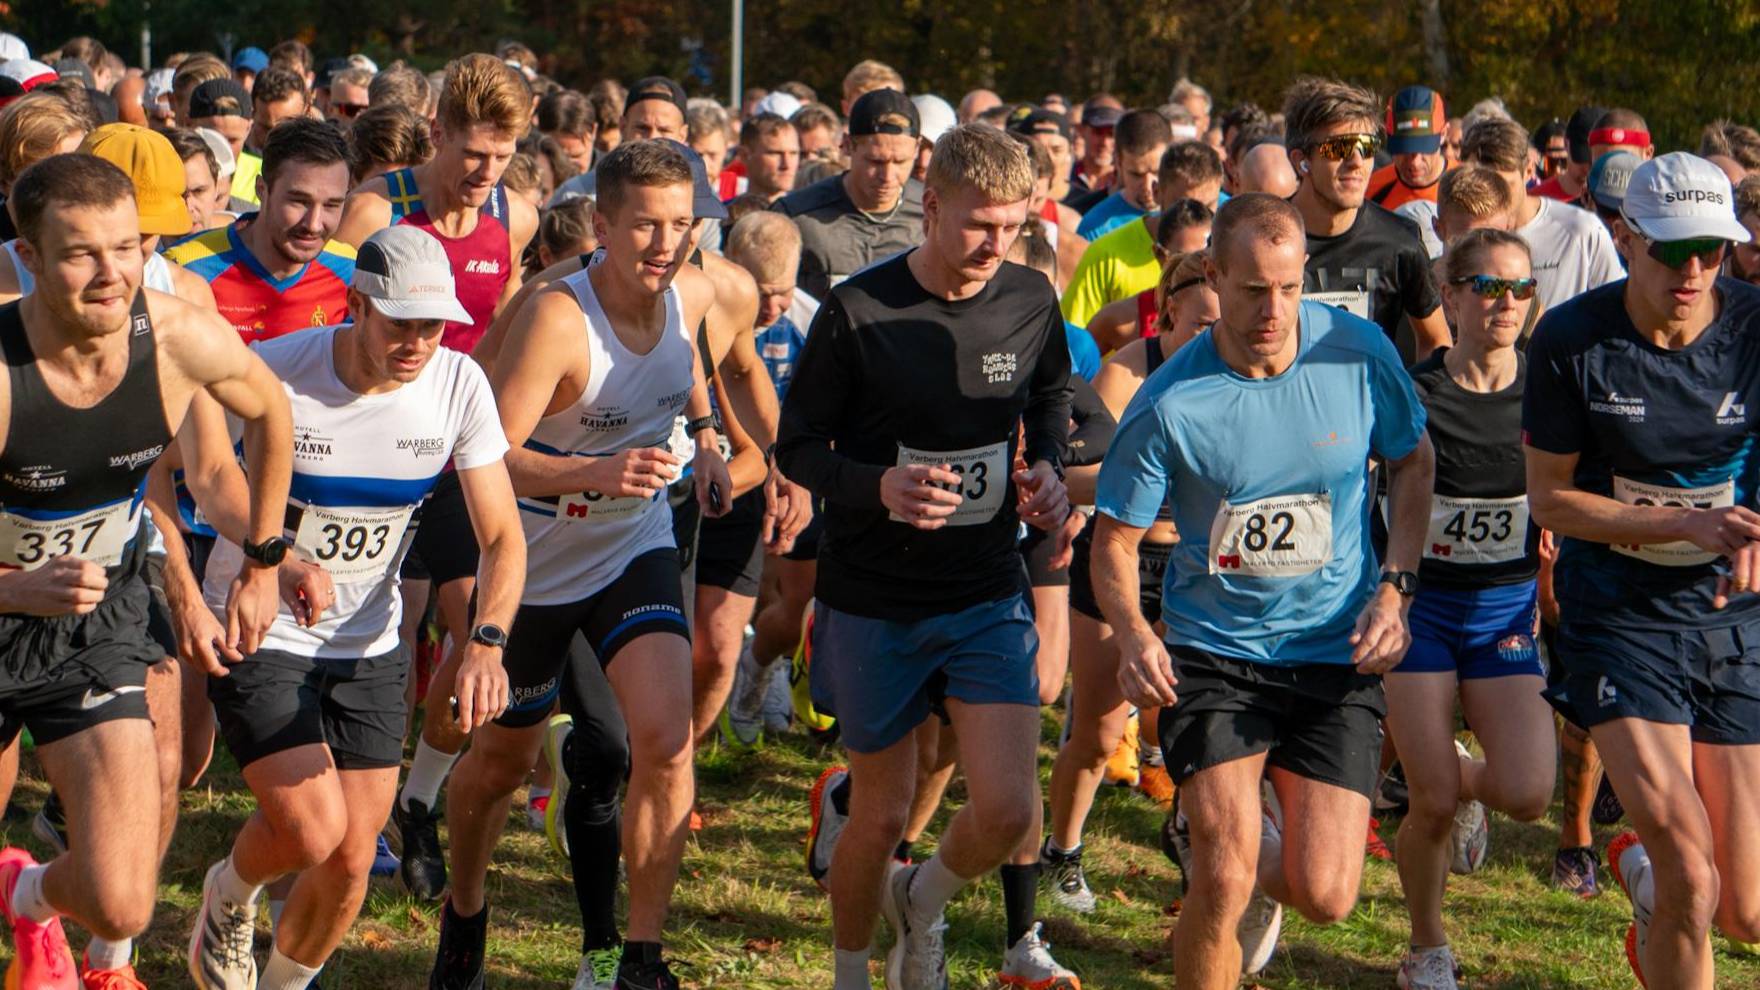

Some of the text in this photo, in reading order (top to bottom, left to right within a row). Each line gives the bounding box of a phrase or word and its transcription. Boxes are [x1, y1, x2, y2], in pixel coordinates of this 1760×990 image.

[1665, 189, 1724, 205] surpas
[1590, 402, 1646, 416] NORSEMAN
[580, 416, 628, 428] HAVANNA
[1716, 415, 1745, 425] surpas
[294, 441, 332, 456] VANNA
[396, 437, 445, 458] WARBERG
[109, 444, 164, 470] WARBERG
[910, 449, 999, 464] Varberg Halvmarathon
[4, 473, 67, 488] HAVANNA
[1623, 482, 1724, 500] Varberg Halvmarathon
[1256, 499, 1319, 511] Halvmarathon
[1440, 499, 1470, 510] Varberg
[12, 506, 120, 532] Varberg Halvmarathon
[315, 511, 404, 525] Varberg Halvmarathon
[1244, 511, 1295, 552] 82
[1443, 510, 1513, 543] 453
[16, 518, 107, 564] 337
[315, 523, 390, 562] 393
[622, 602, 682, 620] noname
